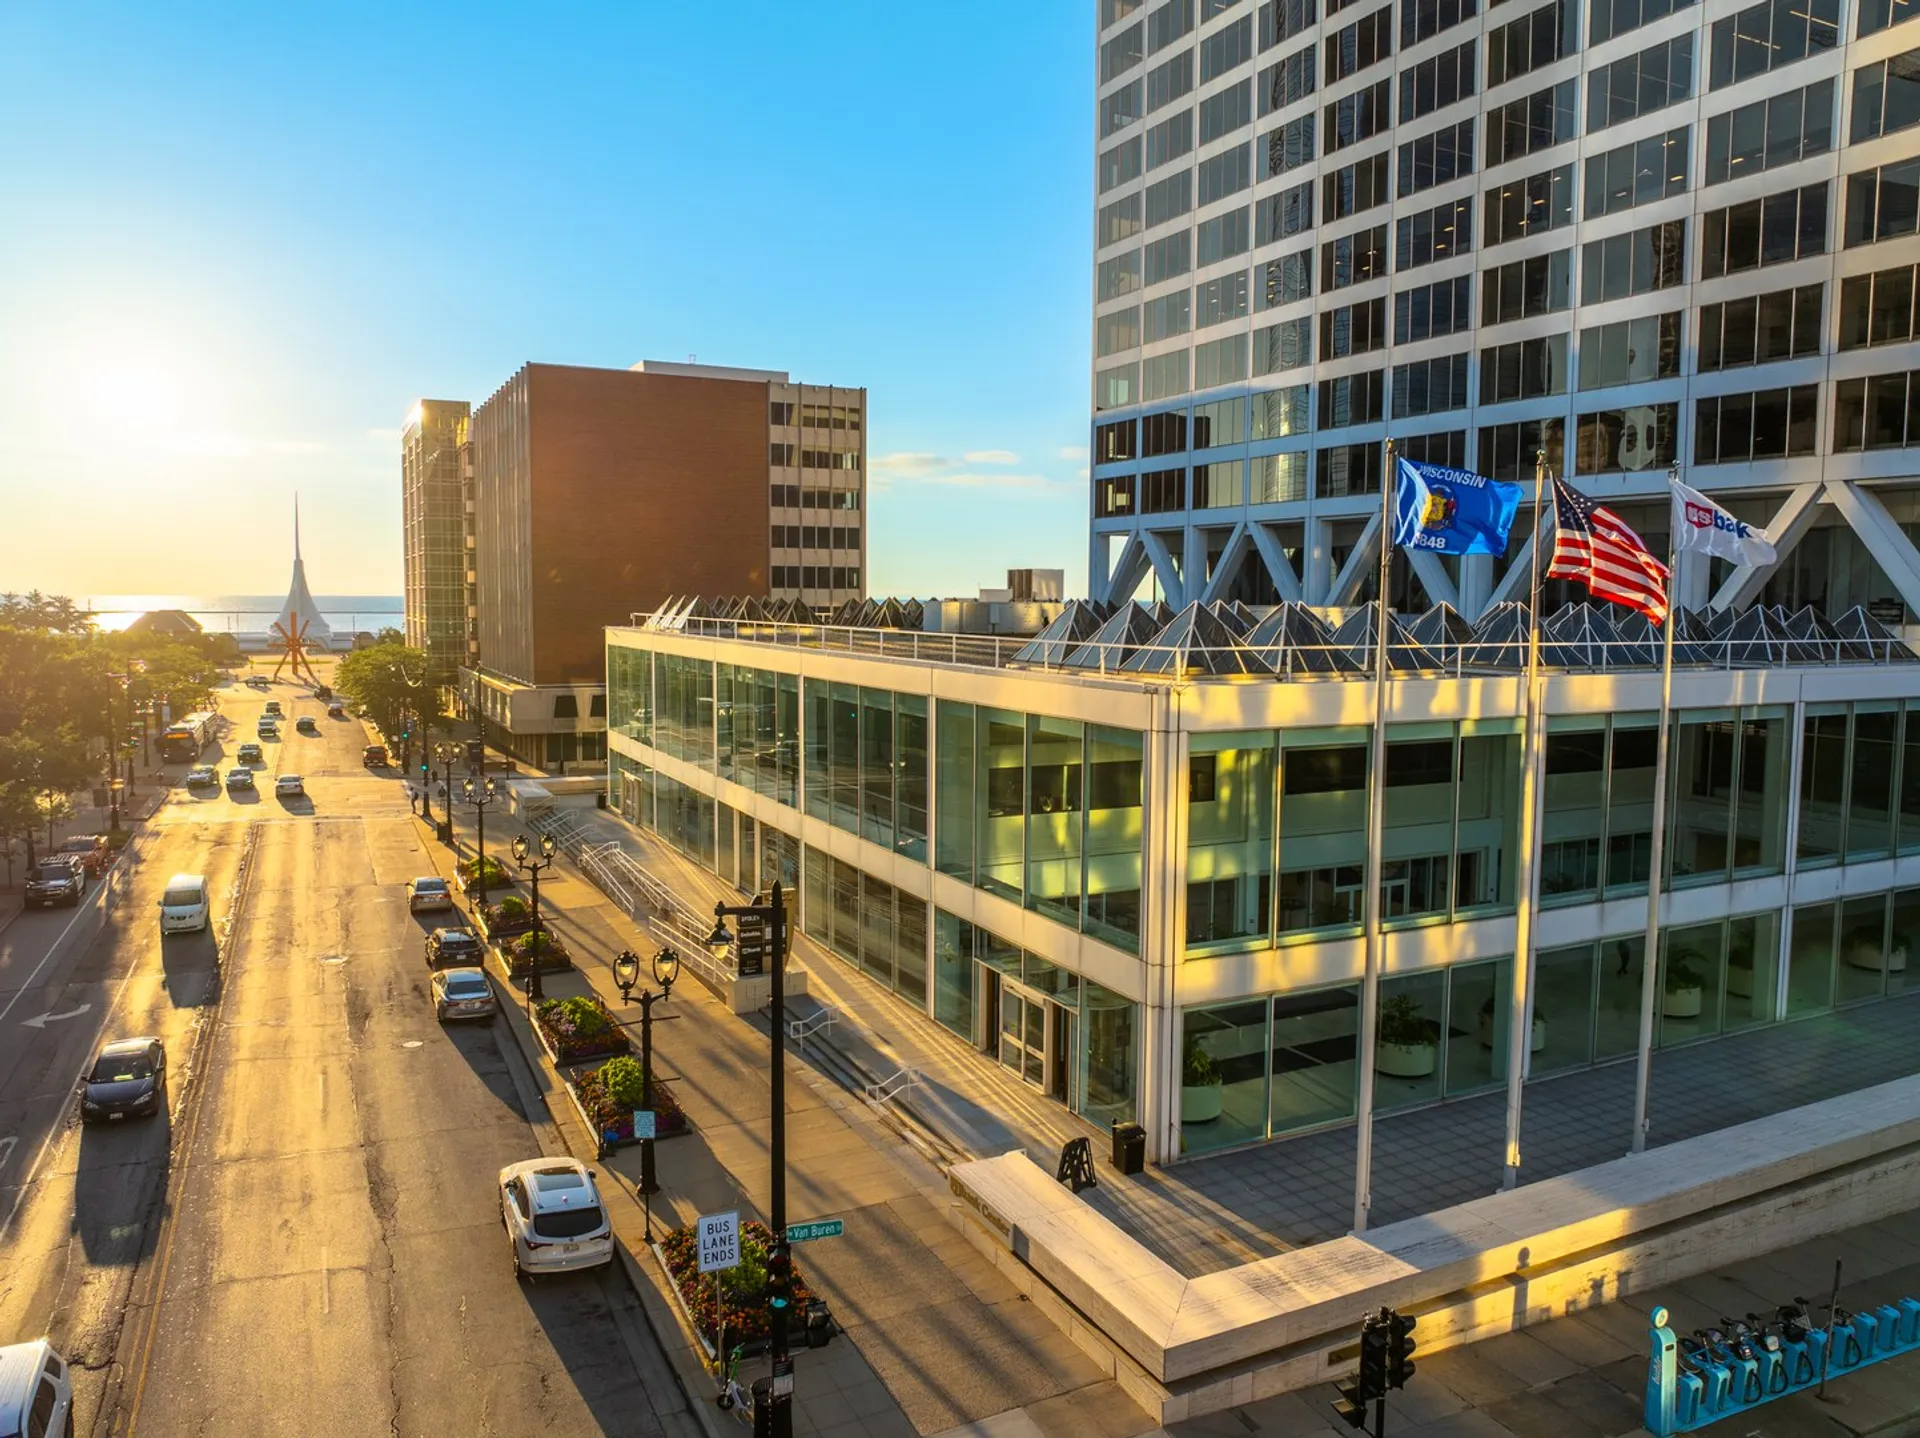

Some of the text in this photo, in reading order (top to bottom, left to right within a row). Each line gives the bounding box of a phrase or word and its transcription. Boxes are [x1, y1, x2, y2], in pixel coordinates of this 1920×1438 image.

[1419, 465, 1487, 489] WISCONSIN
[707, 1220, 730, 1235] BUS
[793, 1227, 808, 1238] Van
[810, 1225, 835, 1236] Buren
[702, 1234, 735, 1250] LANE
[704, 1248, 735, 1264] ENDS
